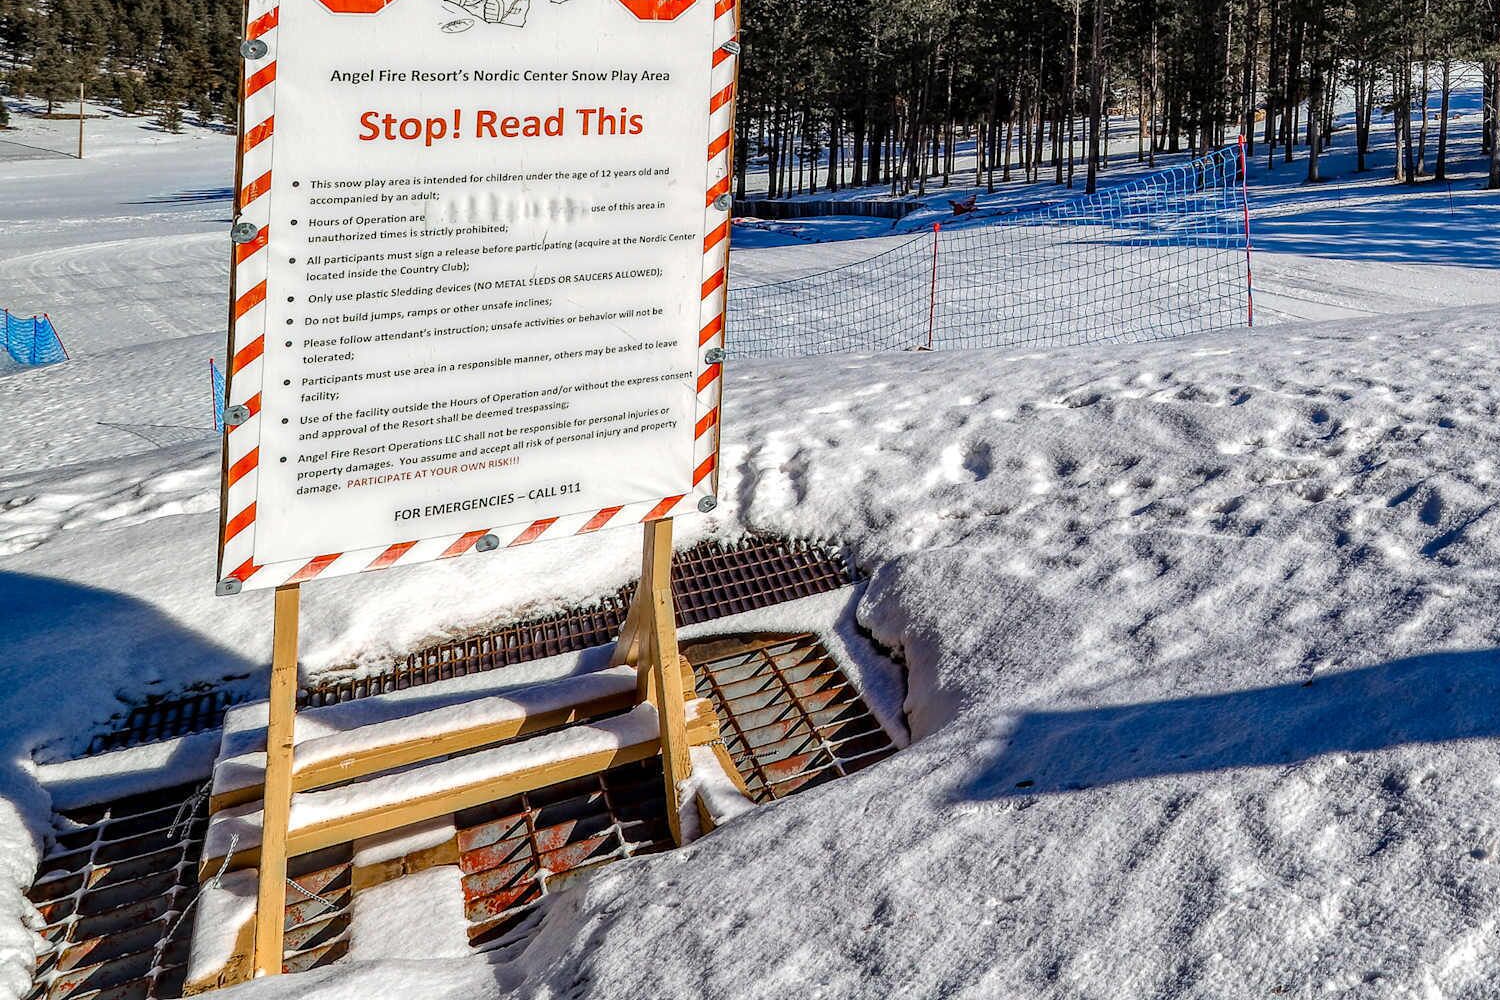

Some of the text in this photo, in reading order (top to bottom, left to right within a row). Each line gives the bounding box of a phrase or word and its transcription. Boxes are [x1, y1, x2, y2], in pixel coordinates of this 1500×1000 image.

[329, 68, 374, 85] Angel
[378, 69, 407, 82] Fire
[473, 69, 520, 81] Nordic
[523, 70, 568, 81] Center
[571, 69, 608, 81] Snow
[610, 69, 638, 84] Play
[639, 70, 669, 81] Area
[358, 106, 643, 147] Stop! Read This
[309, 167, 669, 189] This snow play area intended for children under the age 12 years old and
[309, 193, 379, 205] accompanied
[380, 193, 394, 203] by
[410, 191, 439, 200] adult;
[618, 202, 635, 211] this
[636, 202, 655, 210] area
[308, 214, 426, 227] Hours Operation are
[308, 223, 508, 243] unauthorized times strictly prohibited;
[306, 233, 696, 266] All participants must sign release before participating (acquire the Nordic Center
[306, 261, 469, 281] located inside the Country Club);
[307, 267, 662, 304] Only use plastic Sledding devices (NO METAL SLEDS OR SAUCERS ALLOWED);
[303, 338, 337, 348] Please
[339, 335, 372, 344] follow
[433, 323, 488, 336] instruction;
[490, 320, 522, 330] unsafe
[524, 316, 566, 327] activities
[578, 311, 617, 323] behavior
[618, 309, 634, 318] will
[635, 308, 650, 317] not
[304, 298, 552, 325] Do not build jumps, ramps other unsafe inclines;
[301, 340, 677, 386] Participants must use area responsible manner, others may asked leave
[302, 351, 354, 364] tolerated;
[299, 370, 692, 424] Use the facility outside the Hours Operation and/or without the express consent
[300, 391, 341, 403] facility;
[296, 408, 659, 463] Angel Fire Resort Operations LLC shall not be responsible for personal injuries
[298, 401, 569, 440] and approval the Resort shall deemed trespassing;
[296, 420, 677, 481] property damages. You assume and accept all risk personal injury and property
[296, 456, 520, 495] damage. PARTICIPATE AT YOUR OWN RISK!!!
[393, 481, 581, 521] FOR EMERGENCIES CALL 911
